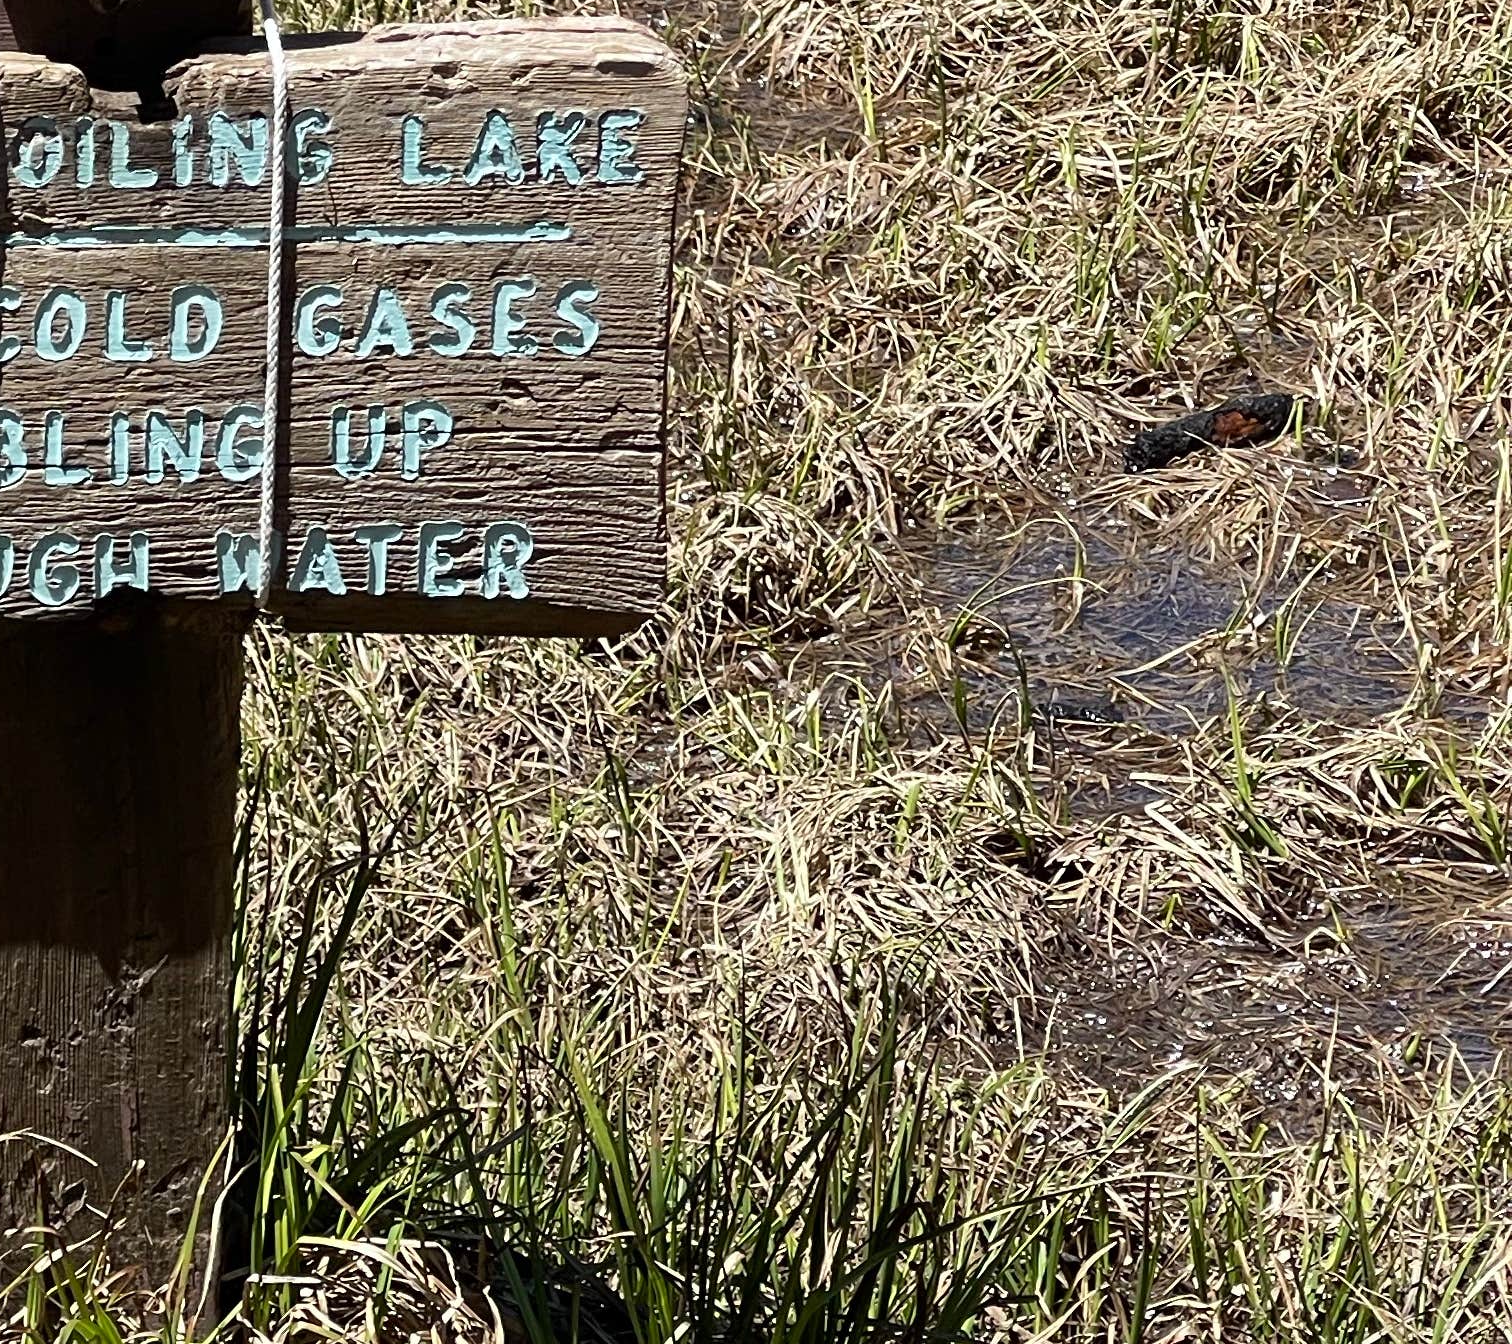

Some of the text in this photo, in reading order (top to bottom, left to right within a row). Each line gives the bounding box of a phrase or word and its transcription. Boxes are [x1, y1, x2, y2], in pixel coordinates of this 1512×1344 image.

[399, 108, 646, 187] LAKE
[295, 274, 600, 358] GASES
[330, 399, 456, 482] UP
[215, 521, 535, 600] WATER
